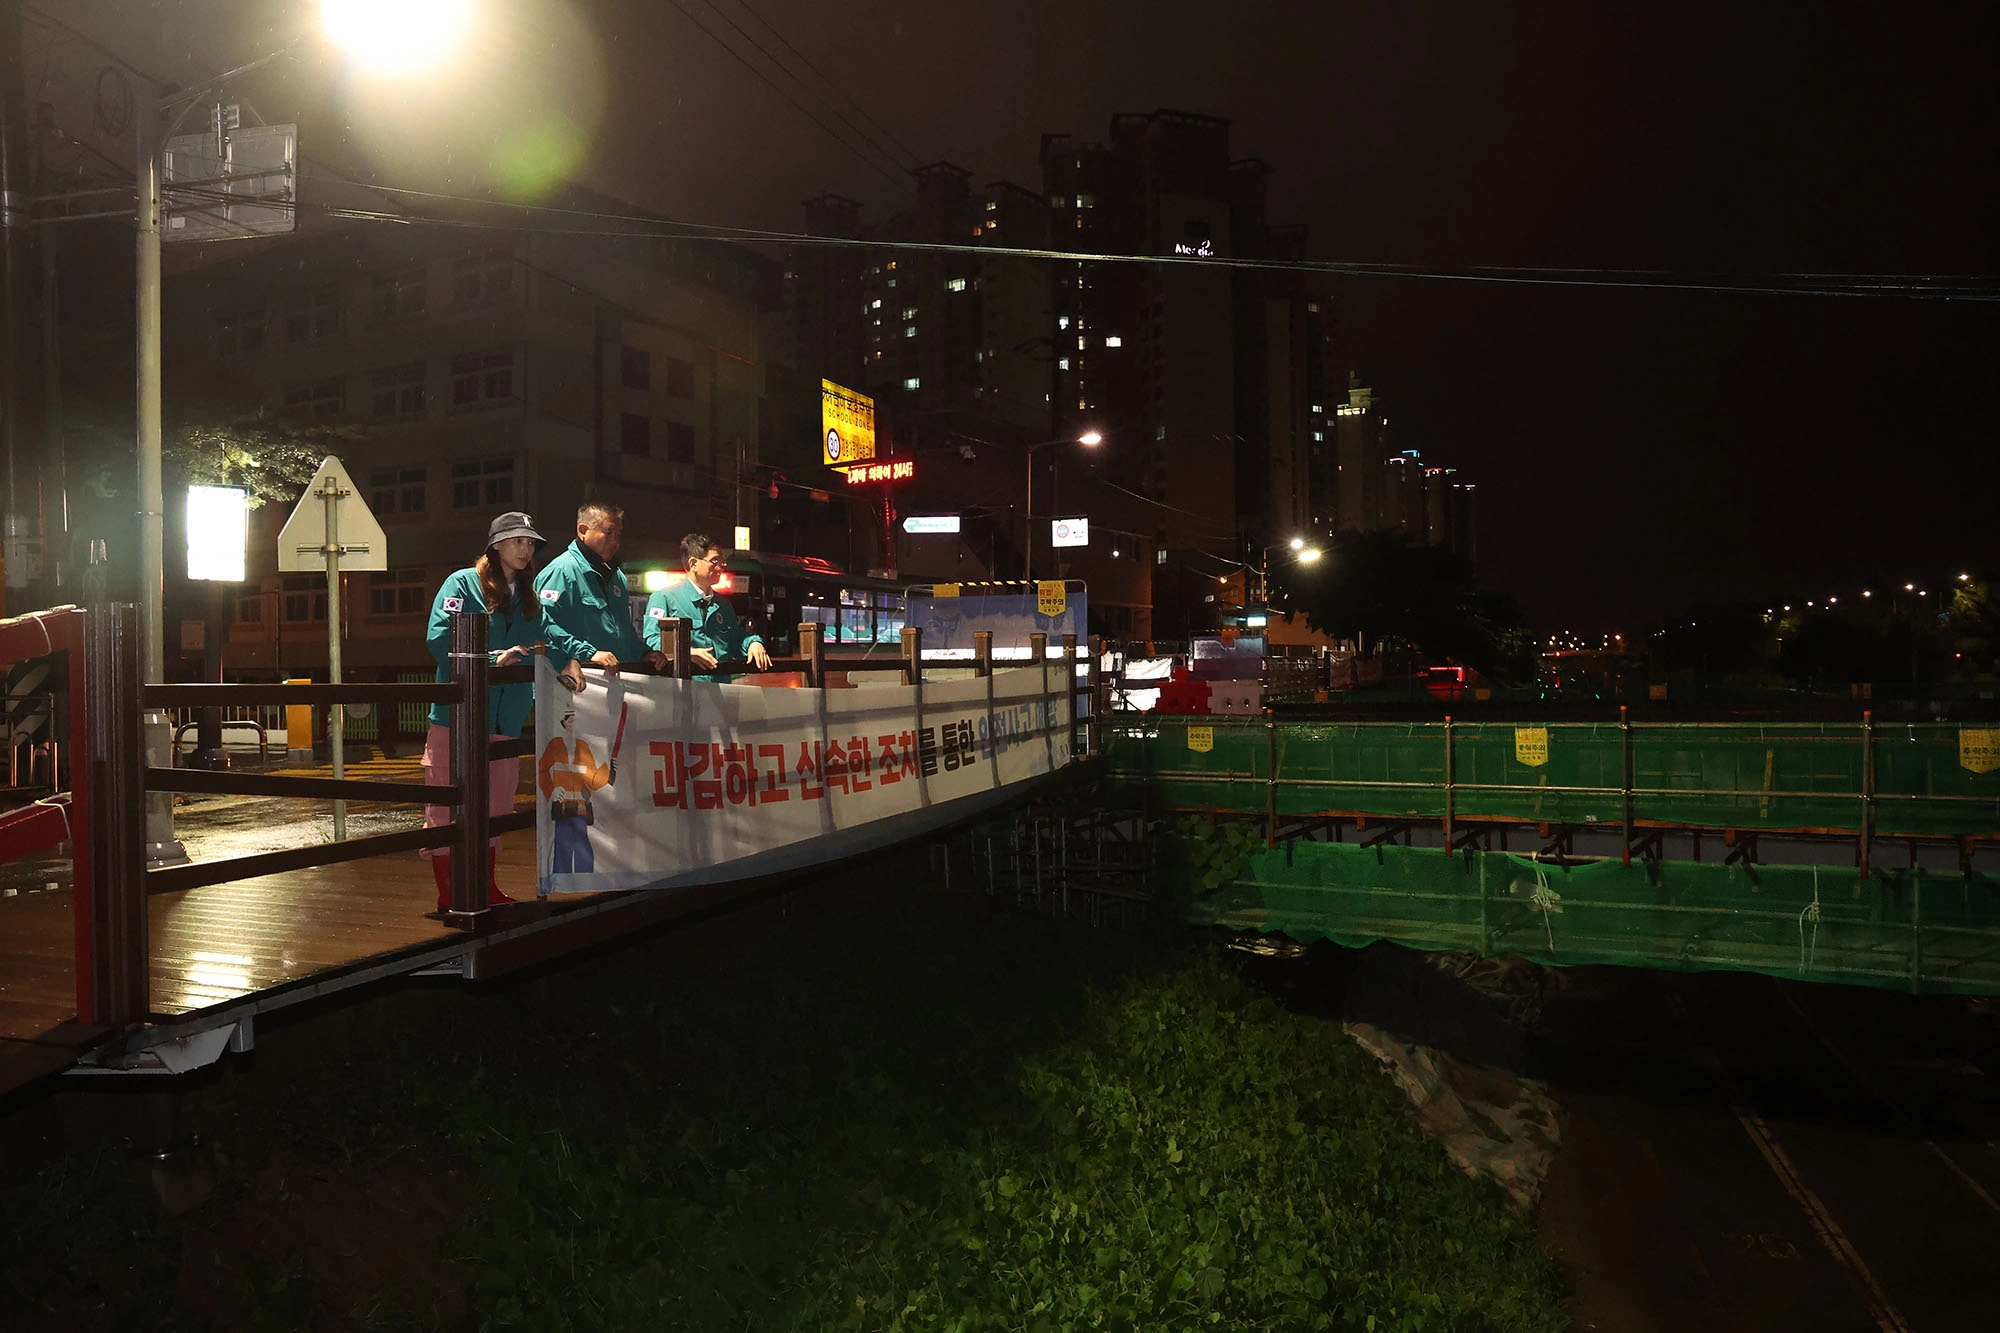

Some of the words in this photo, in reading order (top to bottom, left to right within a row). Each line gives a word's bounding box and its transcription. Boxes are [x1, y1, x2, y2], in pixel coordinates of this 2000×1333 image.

[828, 408, 852, 425] SCHOOL
[855, 417, 870, 431] ZONE
[829, 437, 838, 453] 30
[649, 738, 789, 810] 과감하고
[796, 734, 872, 800] 신속한
[878, 728, 937, 786] 조치를
[941, 719, 975, 772] 통한
